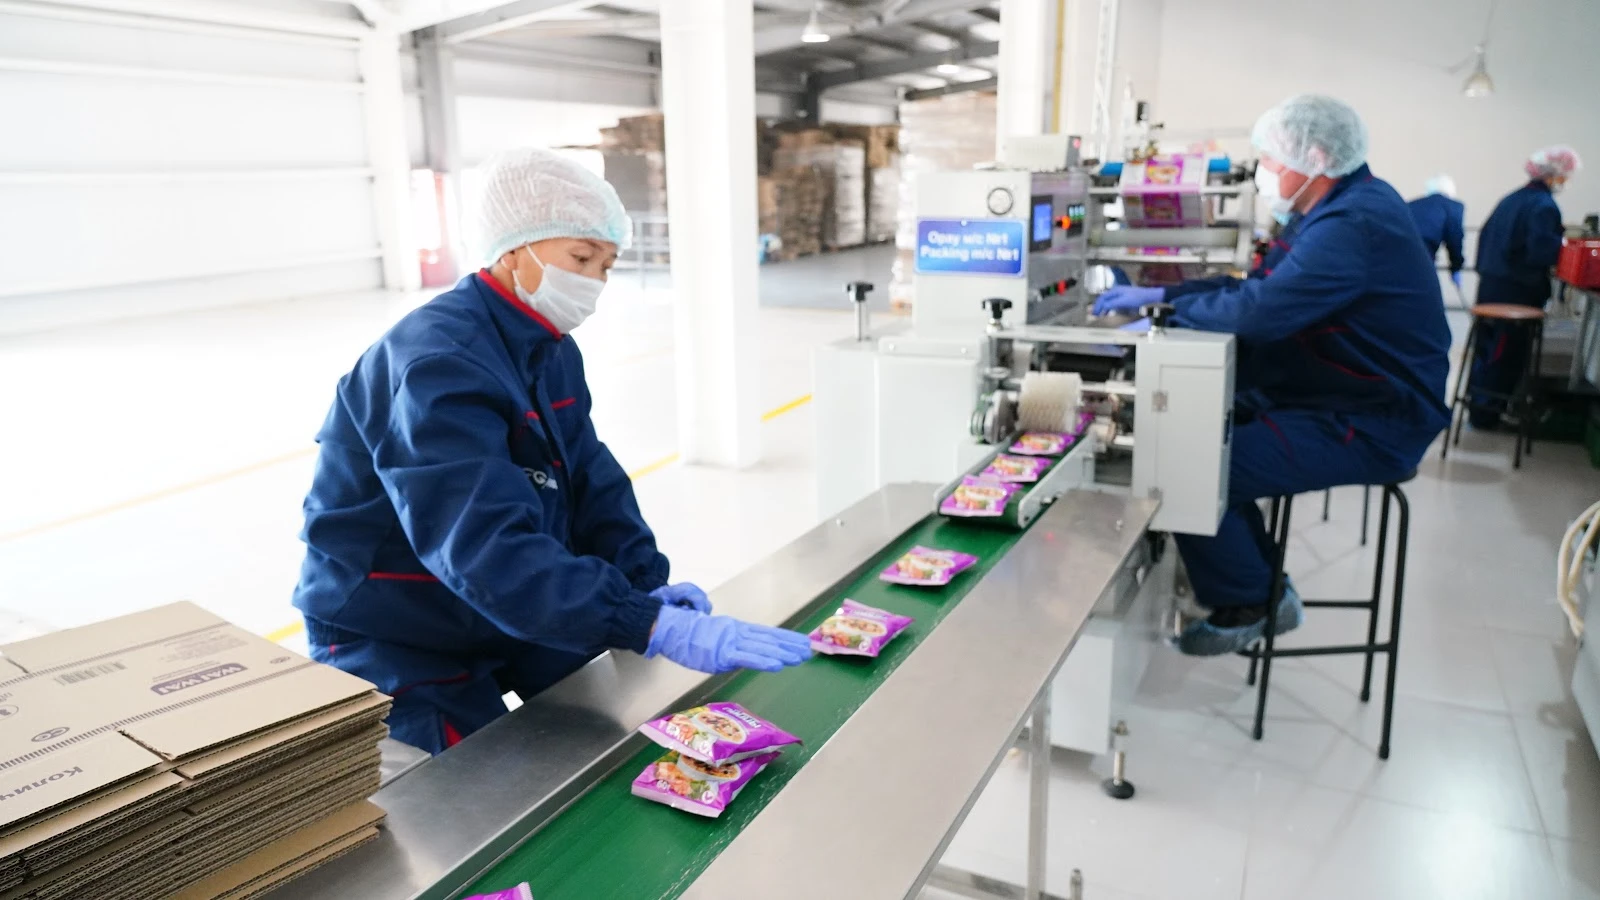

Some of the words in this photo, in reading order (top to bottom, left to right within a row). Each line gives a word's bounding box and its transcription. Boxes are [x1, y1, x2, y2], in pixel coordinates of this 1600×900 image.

[920, 245, 970, 262] Packing
[200, 665, 242, 681] WAI
[157, 678, 199, 694] WAI
